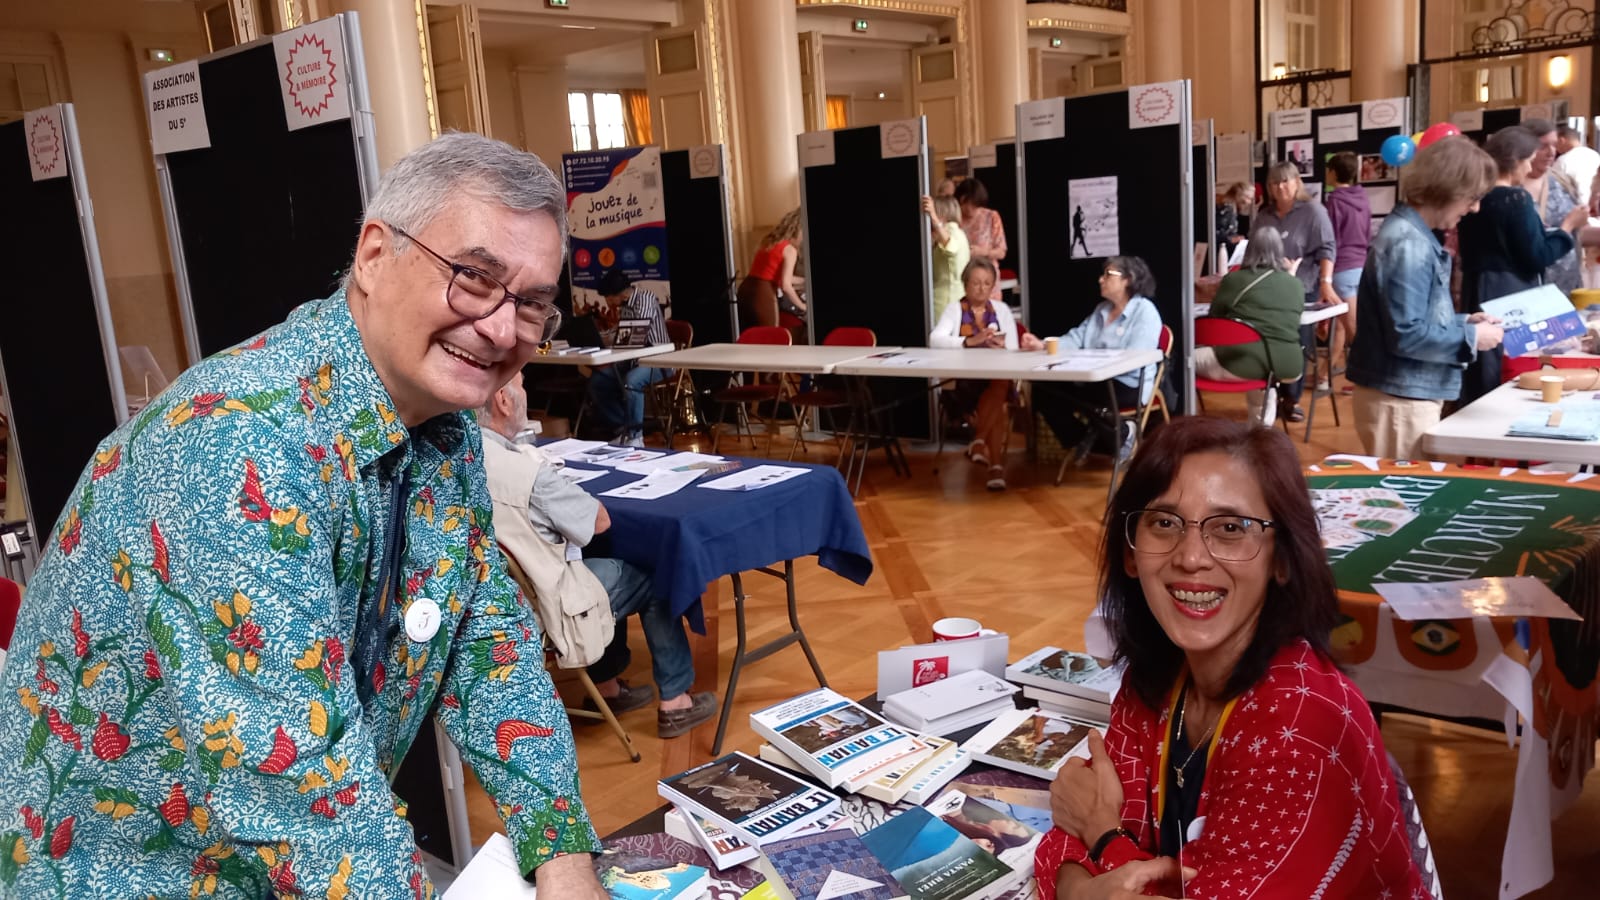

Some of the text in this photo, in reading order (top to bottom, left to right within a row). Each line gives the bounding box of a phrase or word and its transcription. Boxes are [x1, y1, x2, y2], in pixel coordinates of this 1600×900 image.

[297, 61, 320, 76] CULTURE
[153, 72, 195, 91] ASSOCIATION
[153, 92, 199, 112] DES ARTISTES
[168, 120, 178, 131] DU
[627, 193, 639, 206] de
[586, 206, 643, 229] la musique
[885, 726, 902, 739] LE
[816, 732, 881, 767] BANIAN
[806, 791, 831, 805] LE
[744, 802, 810, 836] BANIAN
[943, 857, 975, 878] PANTA
